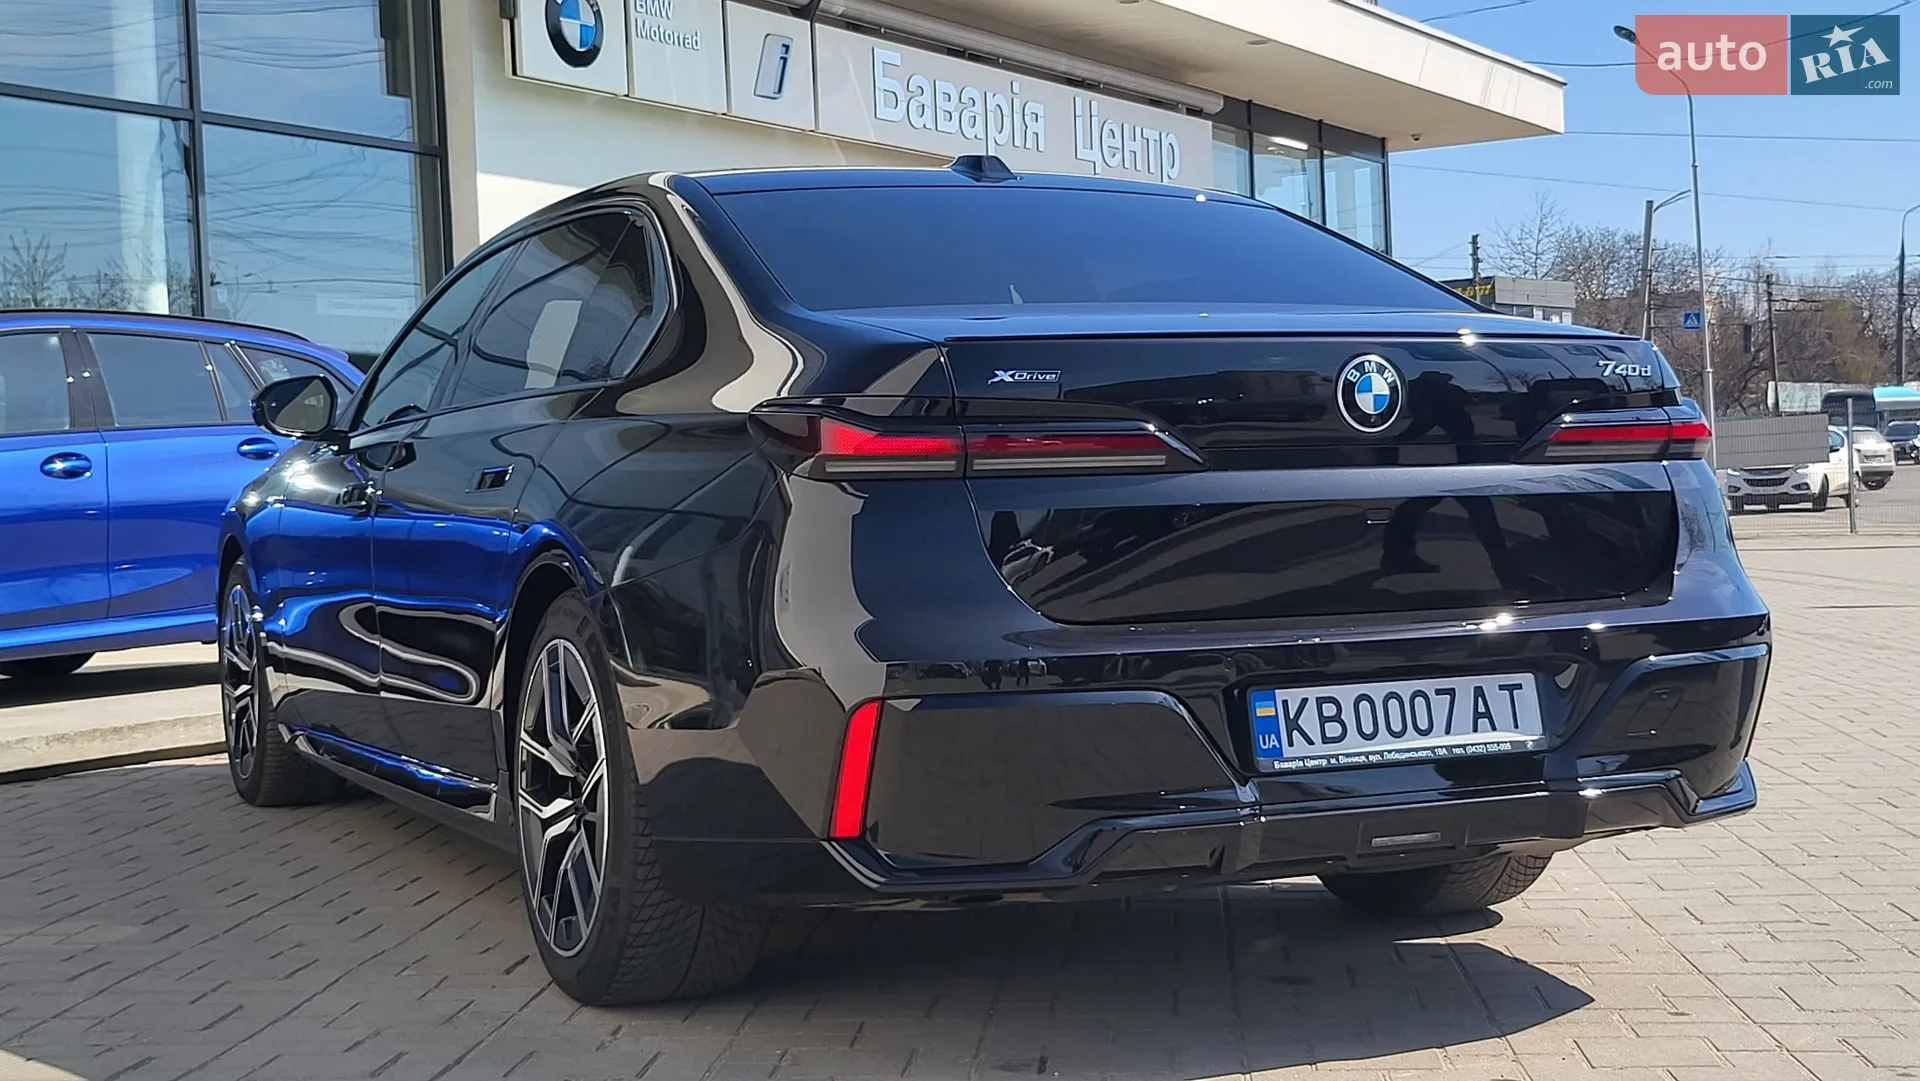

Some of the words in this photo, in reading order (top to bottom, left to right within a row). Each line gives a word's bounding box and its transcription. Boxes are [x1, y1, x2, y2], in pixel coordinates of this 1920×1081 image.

[635, 0, 674, 20] BMW
[635, 18, 701, 51] Motorrad
[872, 46, 1045, 156] Баварія
[1073, 95, 1181, 183] Центр
[1346, 361, 1395, 384] BMW
[1598, 360, 1652, 377] 740d
[1259, 733, 1280, 749] UA
